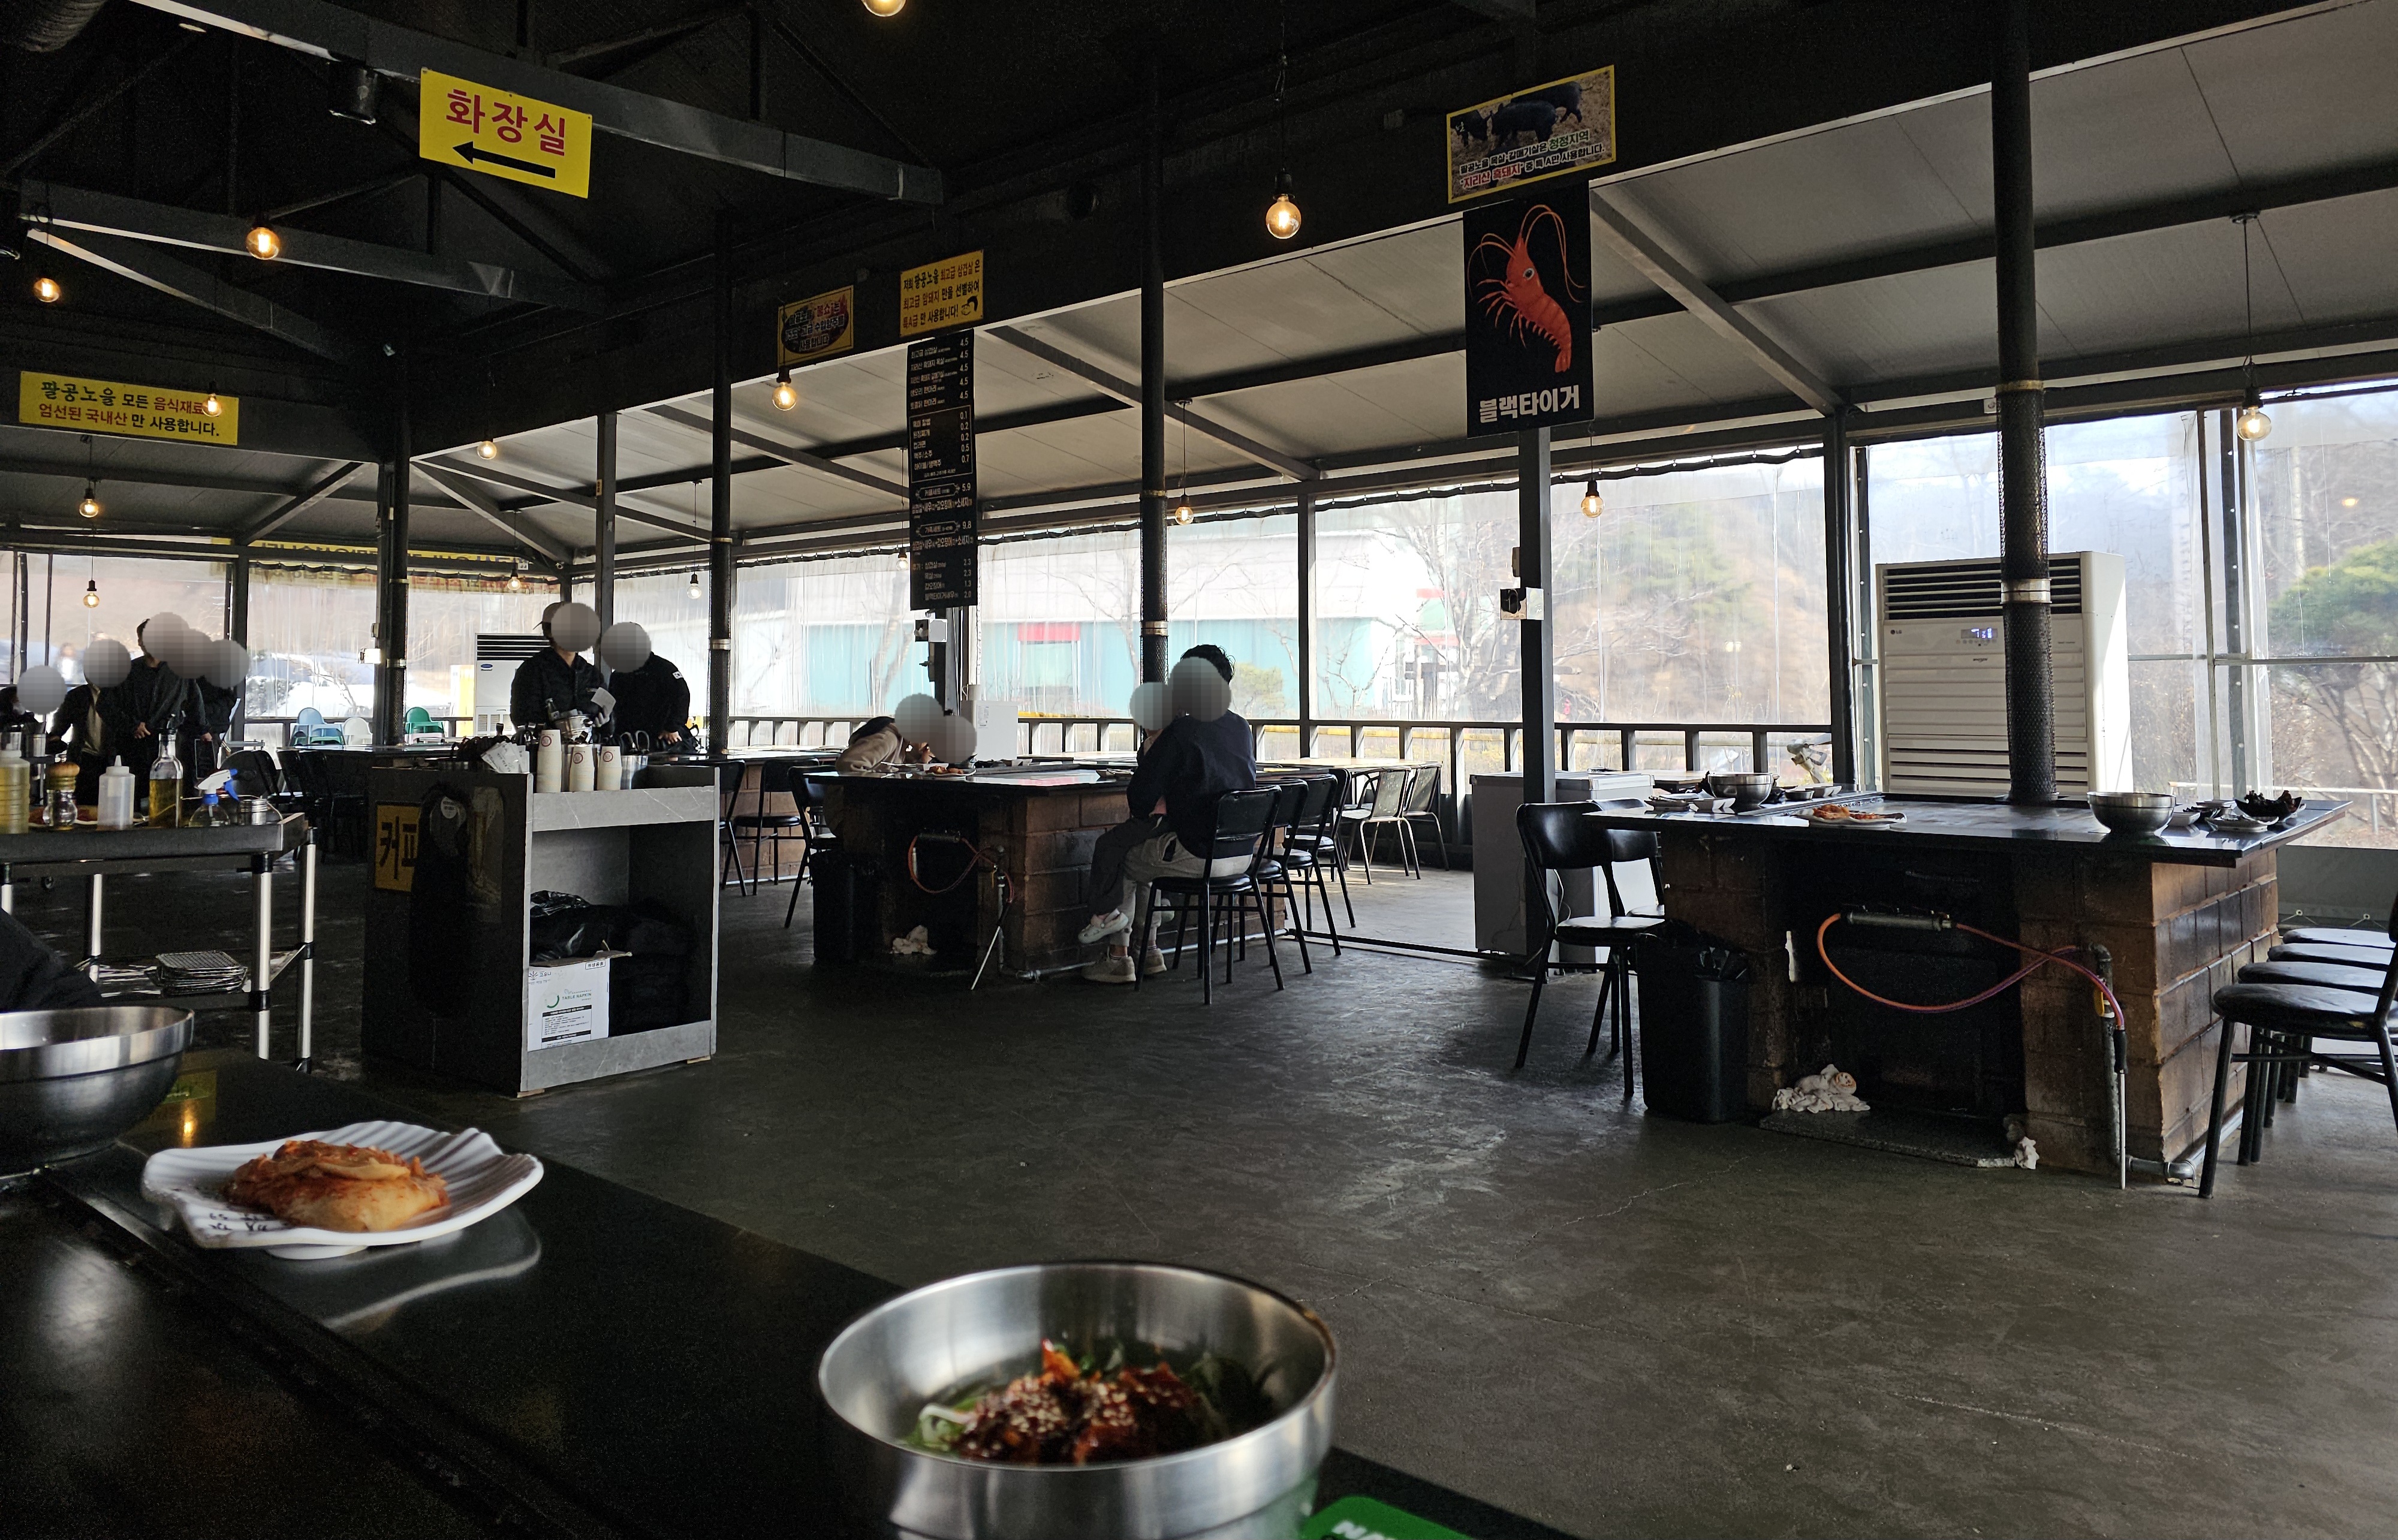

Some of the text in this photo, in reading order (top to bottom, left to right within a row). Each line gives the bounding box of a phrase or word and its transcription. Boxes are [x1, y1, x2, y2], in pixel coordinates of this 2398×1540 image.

[445, 89, 565, 156] 화장실
[1461, 157, 1489, 174] 팔공노을
[1550, 130, 1589, 150] 청정지역
[1561, 144, 1604, 161] 사용합니다.
[903, 276, 913, 290] 저희
[914, 269, 939, 289] 팔공노을
[941, 266, 956, 281] 최고급
[903, 295, 920, 310] 최고급
[956, 279, 979, 297] 선별하여
[960, 337, 969, 346] 4.5
[960, 350, 968, 358] 4.5
[960, 363, 968, 372] 4.5
[960, 377, 968, 385] 4.5
[41, 381, 116, 406] 팔공노을
[122, 394, 149, 409] 모든
[960, 390, 968, 399] 4.5
[1480, 385, 1580, 423] 블랙타이거
[40, 403, 81, 421] 엄선된
[86, 409, 127, 426] 국내산
[150, 417, 219, 436] 사용합니다.
[960, 422, 969, 430] 0.2
[961, 433, 969, 441] 0.2
[962, 483, 971, 492] 5.9
[962, 520, 971, 529] 9.8
